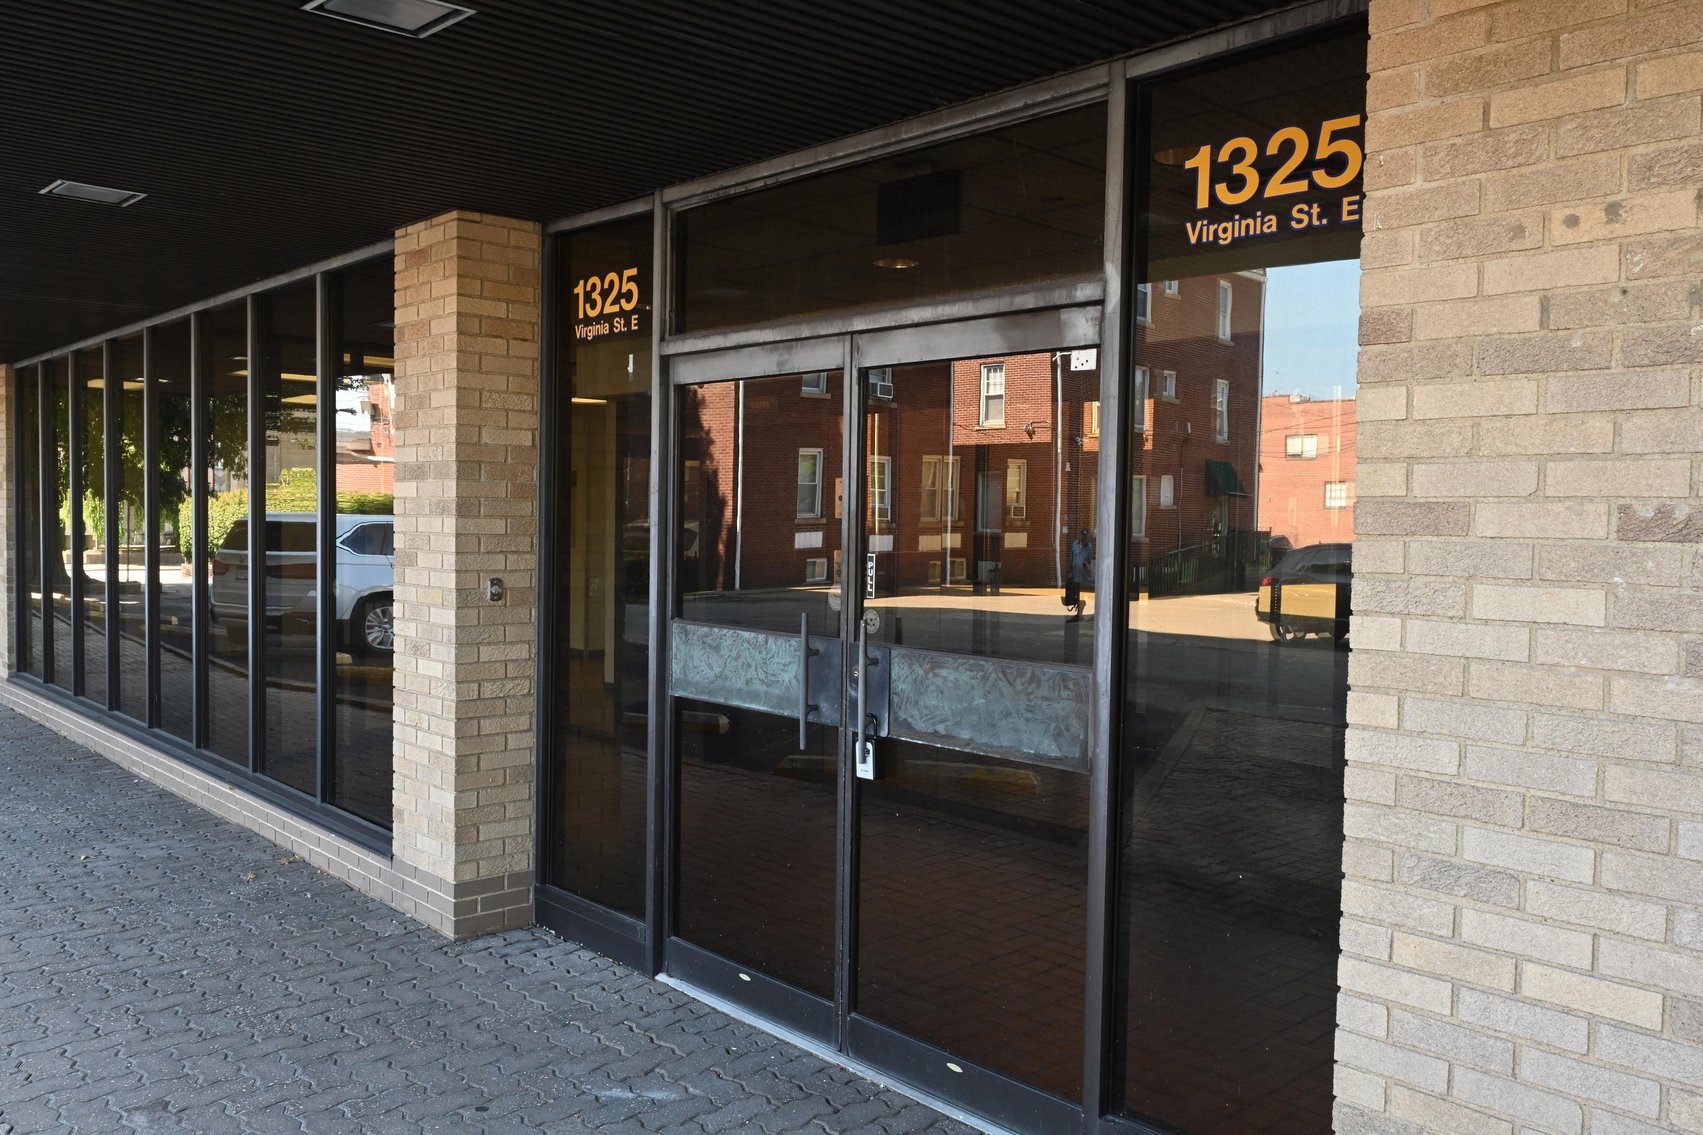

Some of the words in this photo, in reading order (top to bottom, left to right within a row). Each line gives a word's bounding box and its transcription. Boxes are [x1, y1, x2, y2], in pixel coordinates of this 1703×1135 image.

[1185, 114, 1363, 209] 1325
[1186, 211, 1277, 245] Virginia
[1290, 203, 1328, 229] St.
[1342, 195, 1360, 222] E
[573, 267, 639, 319] 1325
[575, 320, 609, 340] Virginia
[613, 317, 627, 333] St.
[631, 314, 639, 330] E
